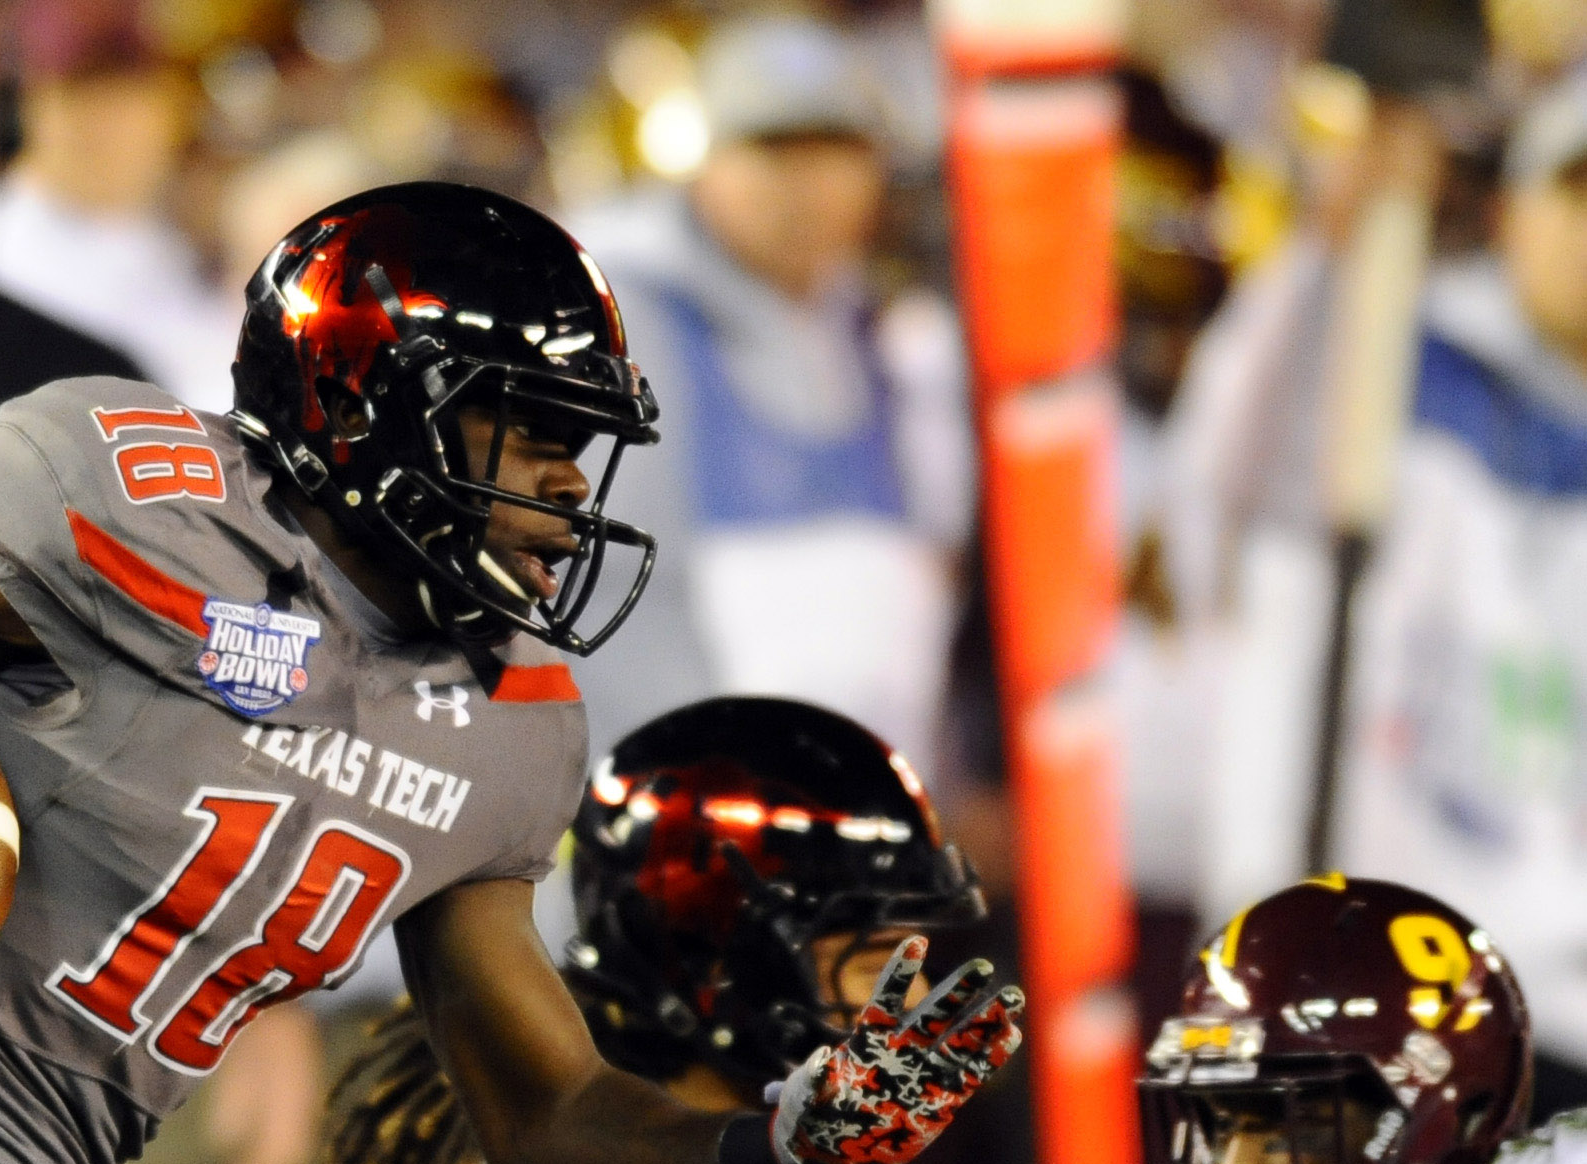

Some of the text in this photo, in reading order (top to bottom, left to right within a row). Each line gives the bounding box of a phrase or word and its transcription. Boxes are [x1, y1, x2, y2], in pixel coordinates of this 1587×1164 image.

[89, 405, 228, 505] 18
[209, 603, 254, 621] NATIONAL
[209, 617, 308, 667] HOLIDAY
[214, 652, 293, 697] BOWL
[369, 749, 472, 833] TECH
[44, 787, 412, 1076] 18
